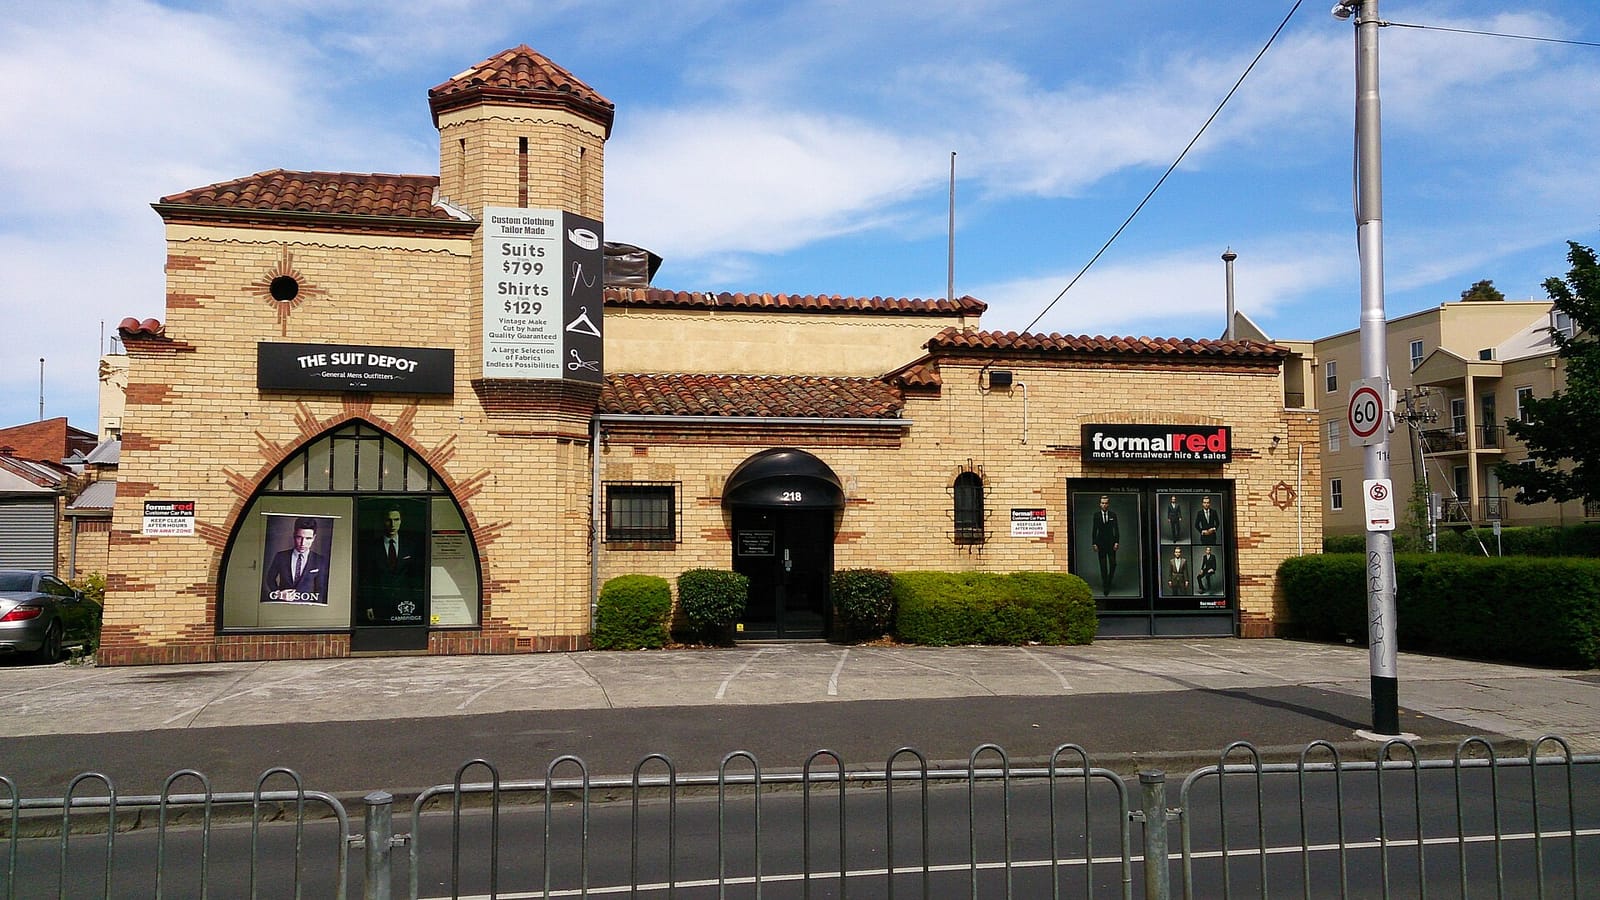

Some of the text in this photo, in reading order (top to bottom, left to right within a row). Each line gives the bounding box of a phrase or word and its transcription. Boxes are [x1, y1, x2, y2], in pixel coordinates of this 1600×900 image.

[491, 216, 555, 227] Custom Clothing
[501, 225, 545, 235] Tailor Made
[502, 243, 545, 257] Suits
[503, 260, 544, 275] $799
[498, 281, 549, 296] Shirts
[504, 299, 542, 315] $129
[297, 352, 419, 373] THE SUIT DEPOT
[1354, 400, 1376, 424] 60
[1092, 428, 1226, 452] formalred
[1092, 450, 1119, 458] men's
[1121, 451, 1173, 459] formalwear
[1174, 451, 1192, 459] hire
[1203, 452, 1226, 460] sales
[782, 491, 802, 501] 218
[145, 502, 193, 510] formalred
